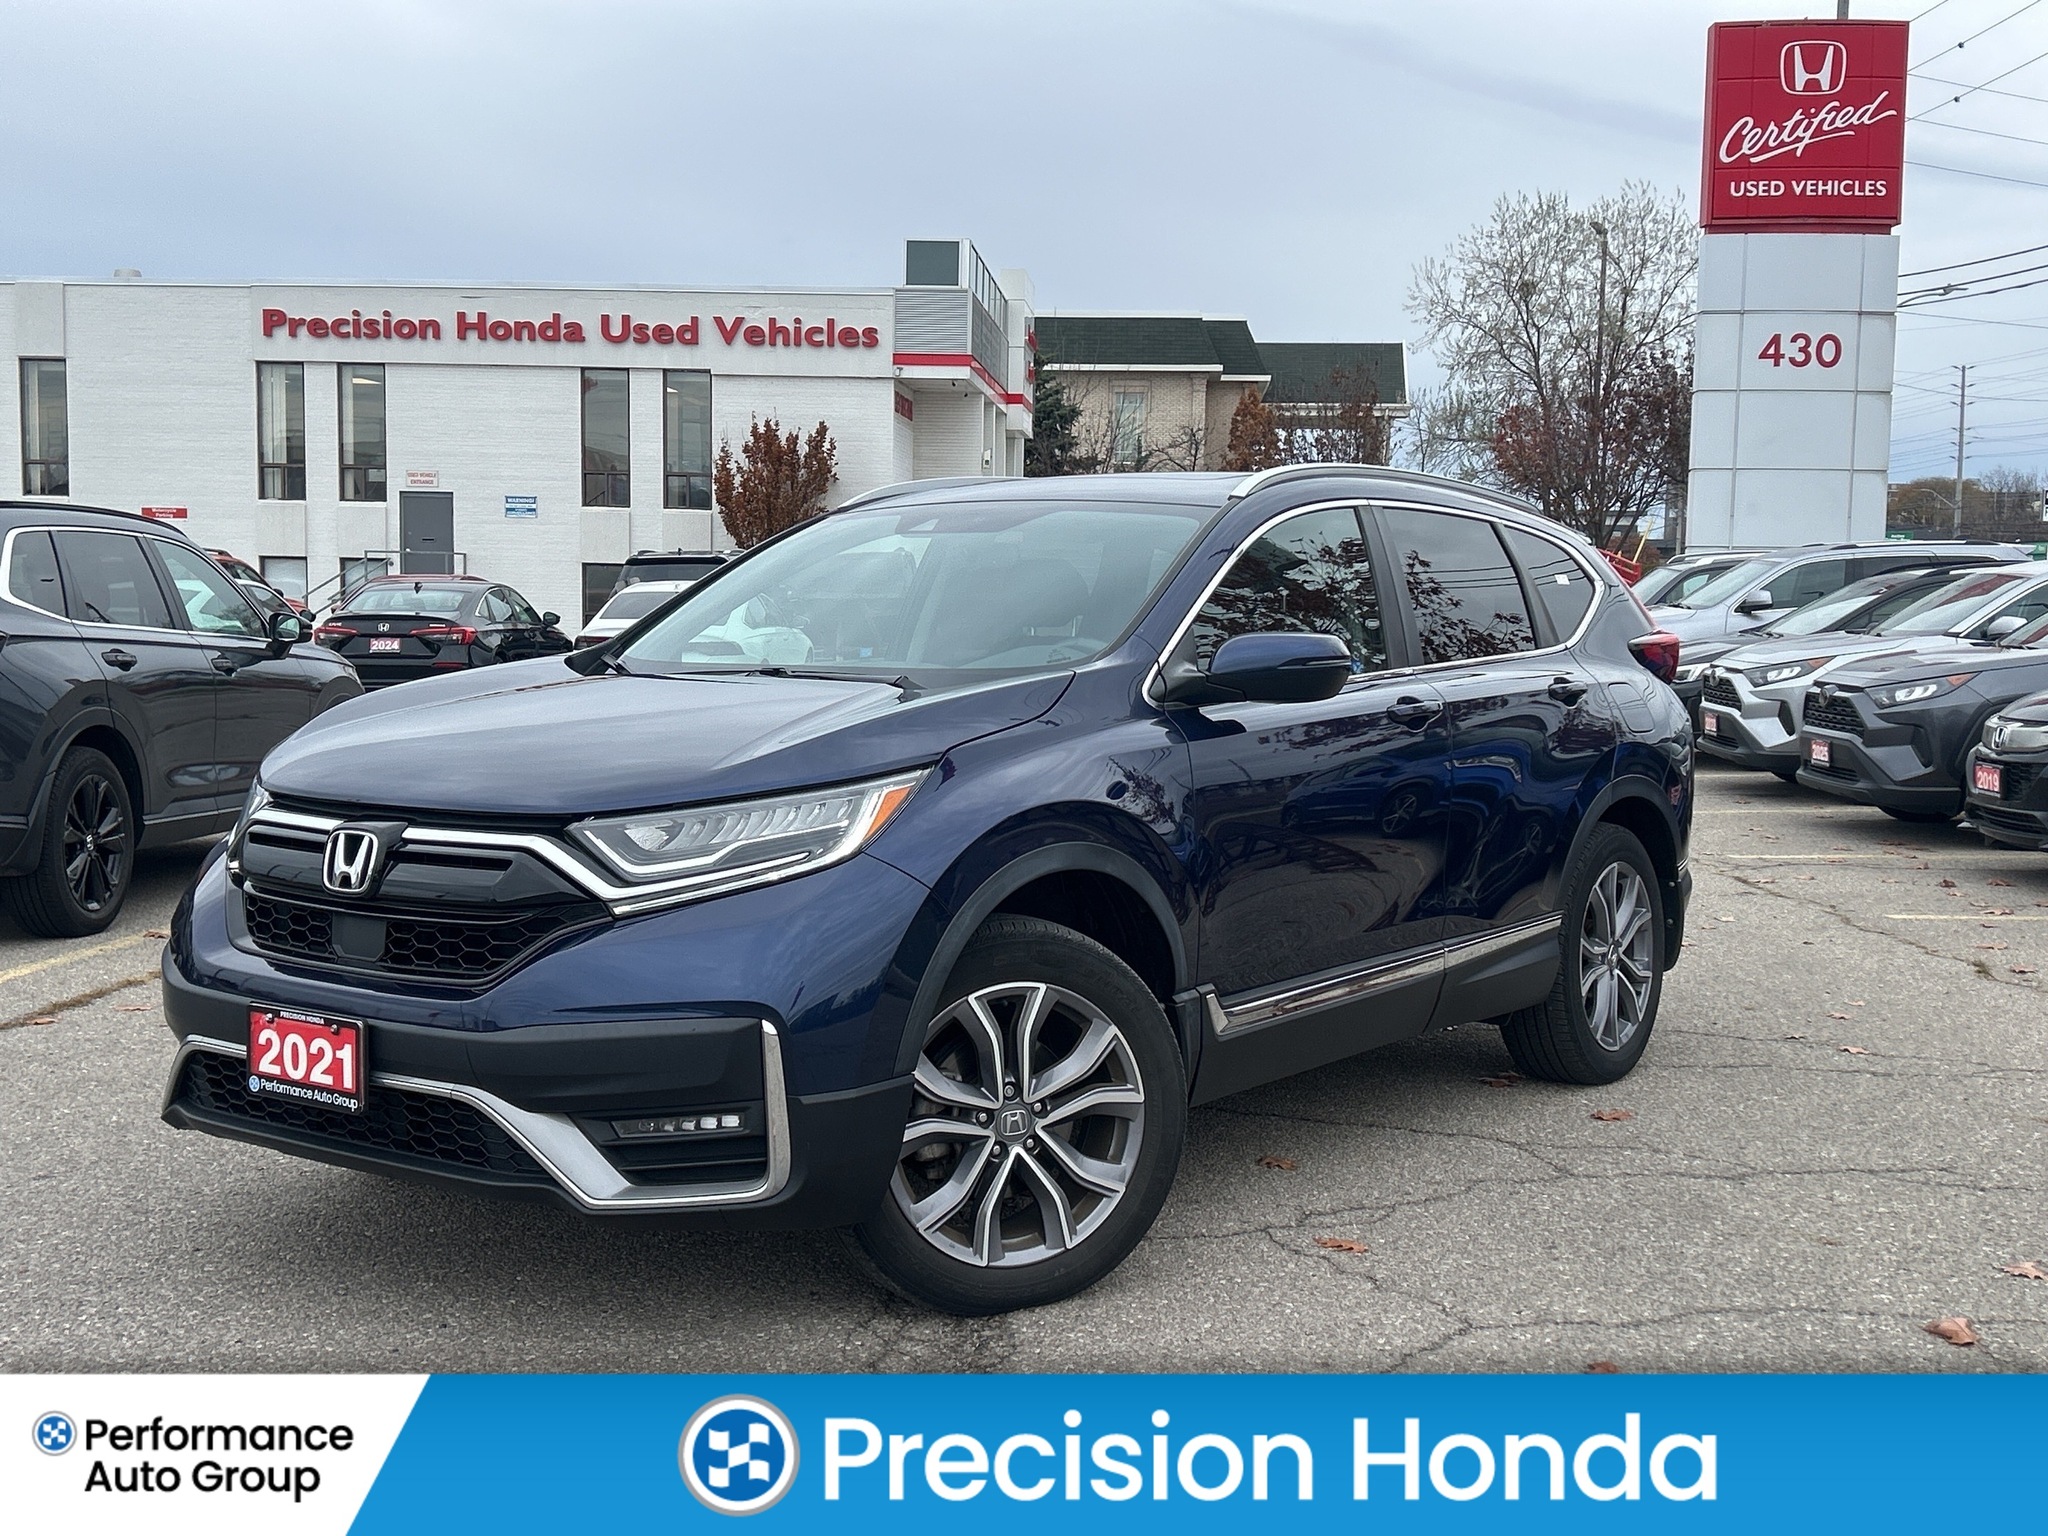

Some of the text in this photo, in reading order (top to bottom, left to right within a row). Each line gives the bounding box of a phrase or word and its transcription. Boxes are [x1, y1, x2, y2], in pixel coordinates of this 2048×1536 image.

[1719, 91, 1898, 163] Certified
[1730, 180, 1887, 197] USED VEHICLES
[262, 308, 879, 348] Precision Honda Used Vehicles
[1758, 332, 1842, 368] 430
[371, 639, 399, 650] 2024
[1977, 771, 2000, 792] 2019
[280, 1011, 324, 1025] PRECISION HONDA
[258, 1028, 353, 1090] 2021
[260, 1078, 358, 1112] Performance Auto Group
